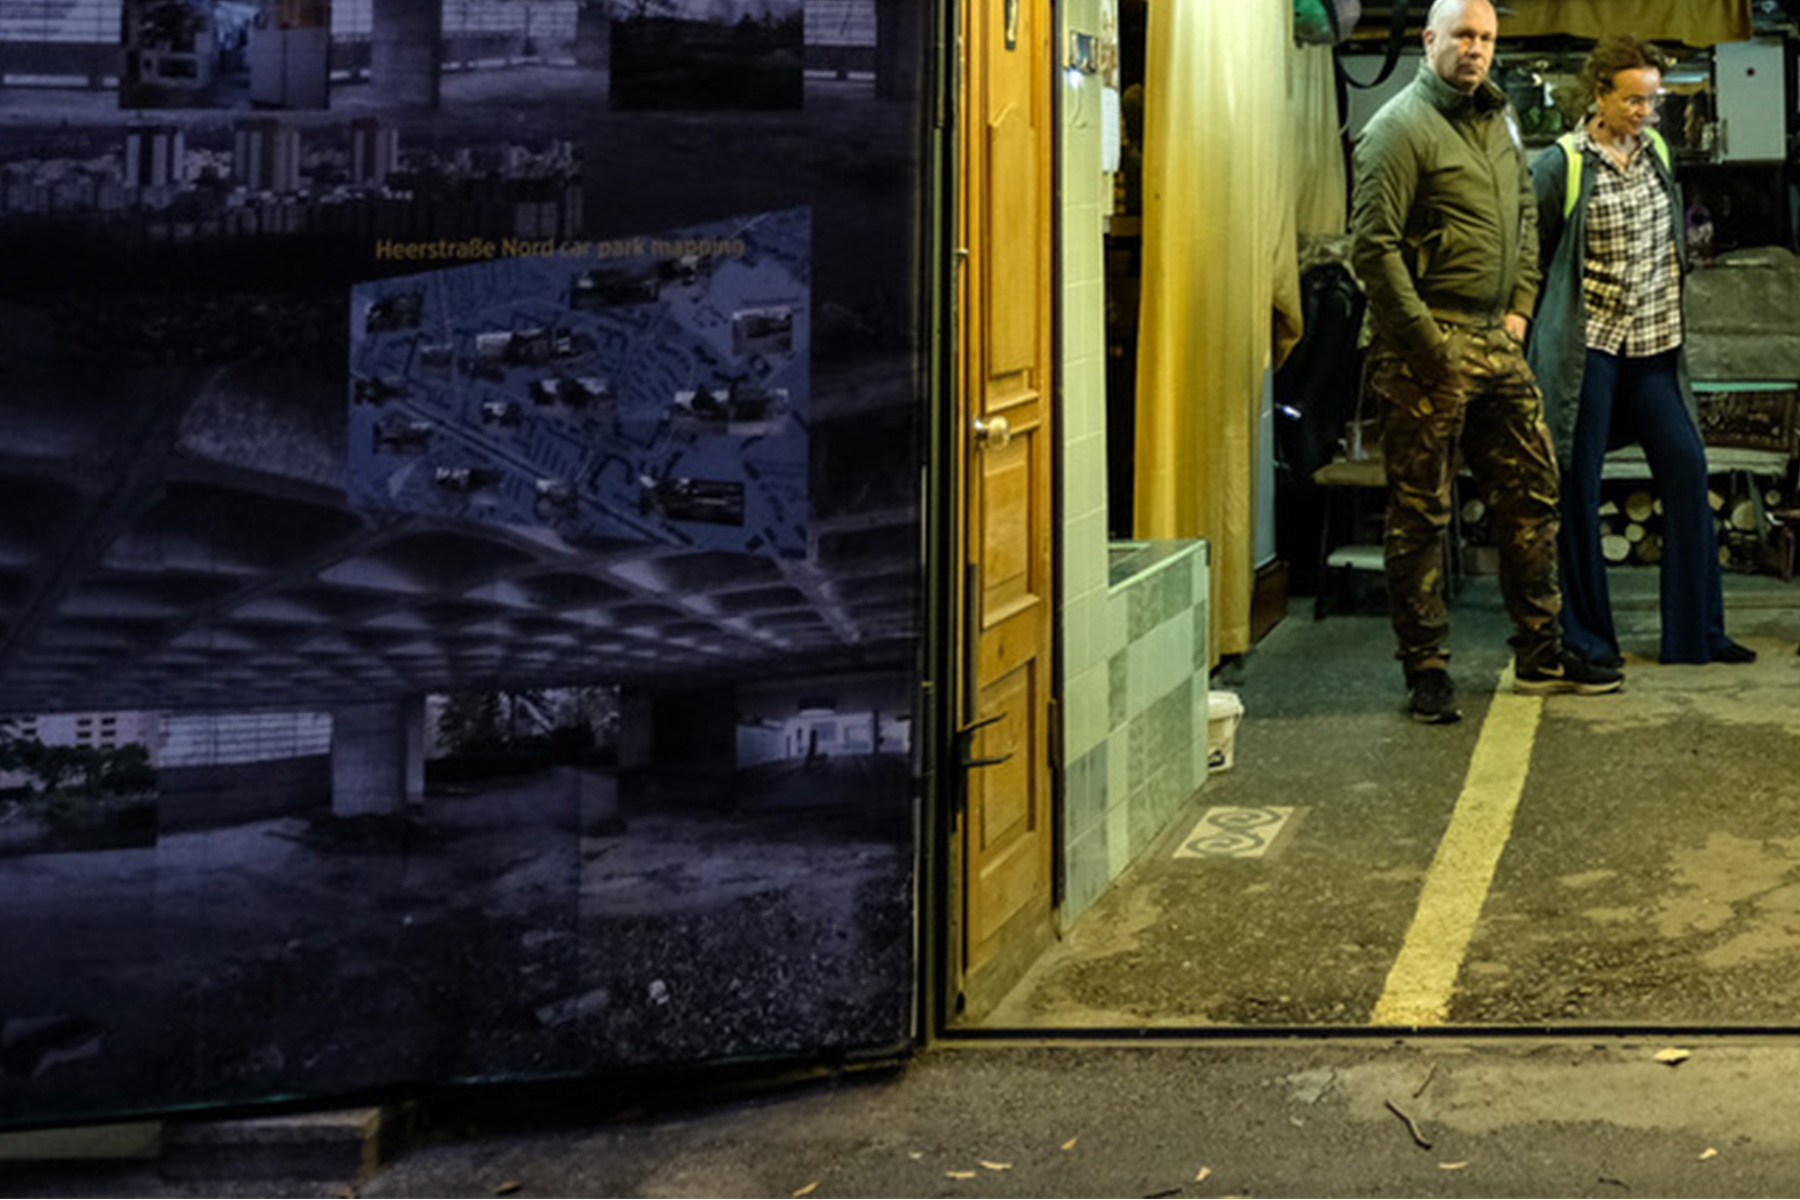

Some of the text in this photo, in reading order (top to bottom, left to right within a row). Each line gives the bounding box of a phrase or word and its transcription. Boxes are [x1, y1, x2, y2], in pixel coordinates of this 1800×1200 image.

[375, 236, 746, 260] Heerstraße Nord car park mapping
